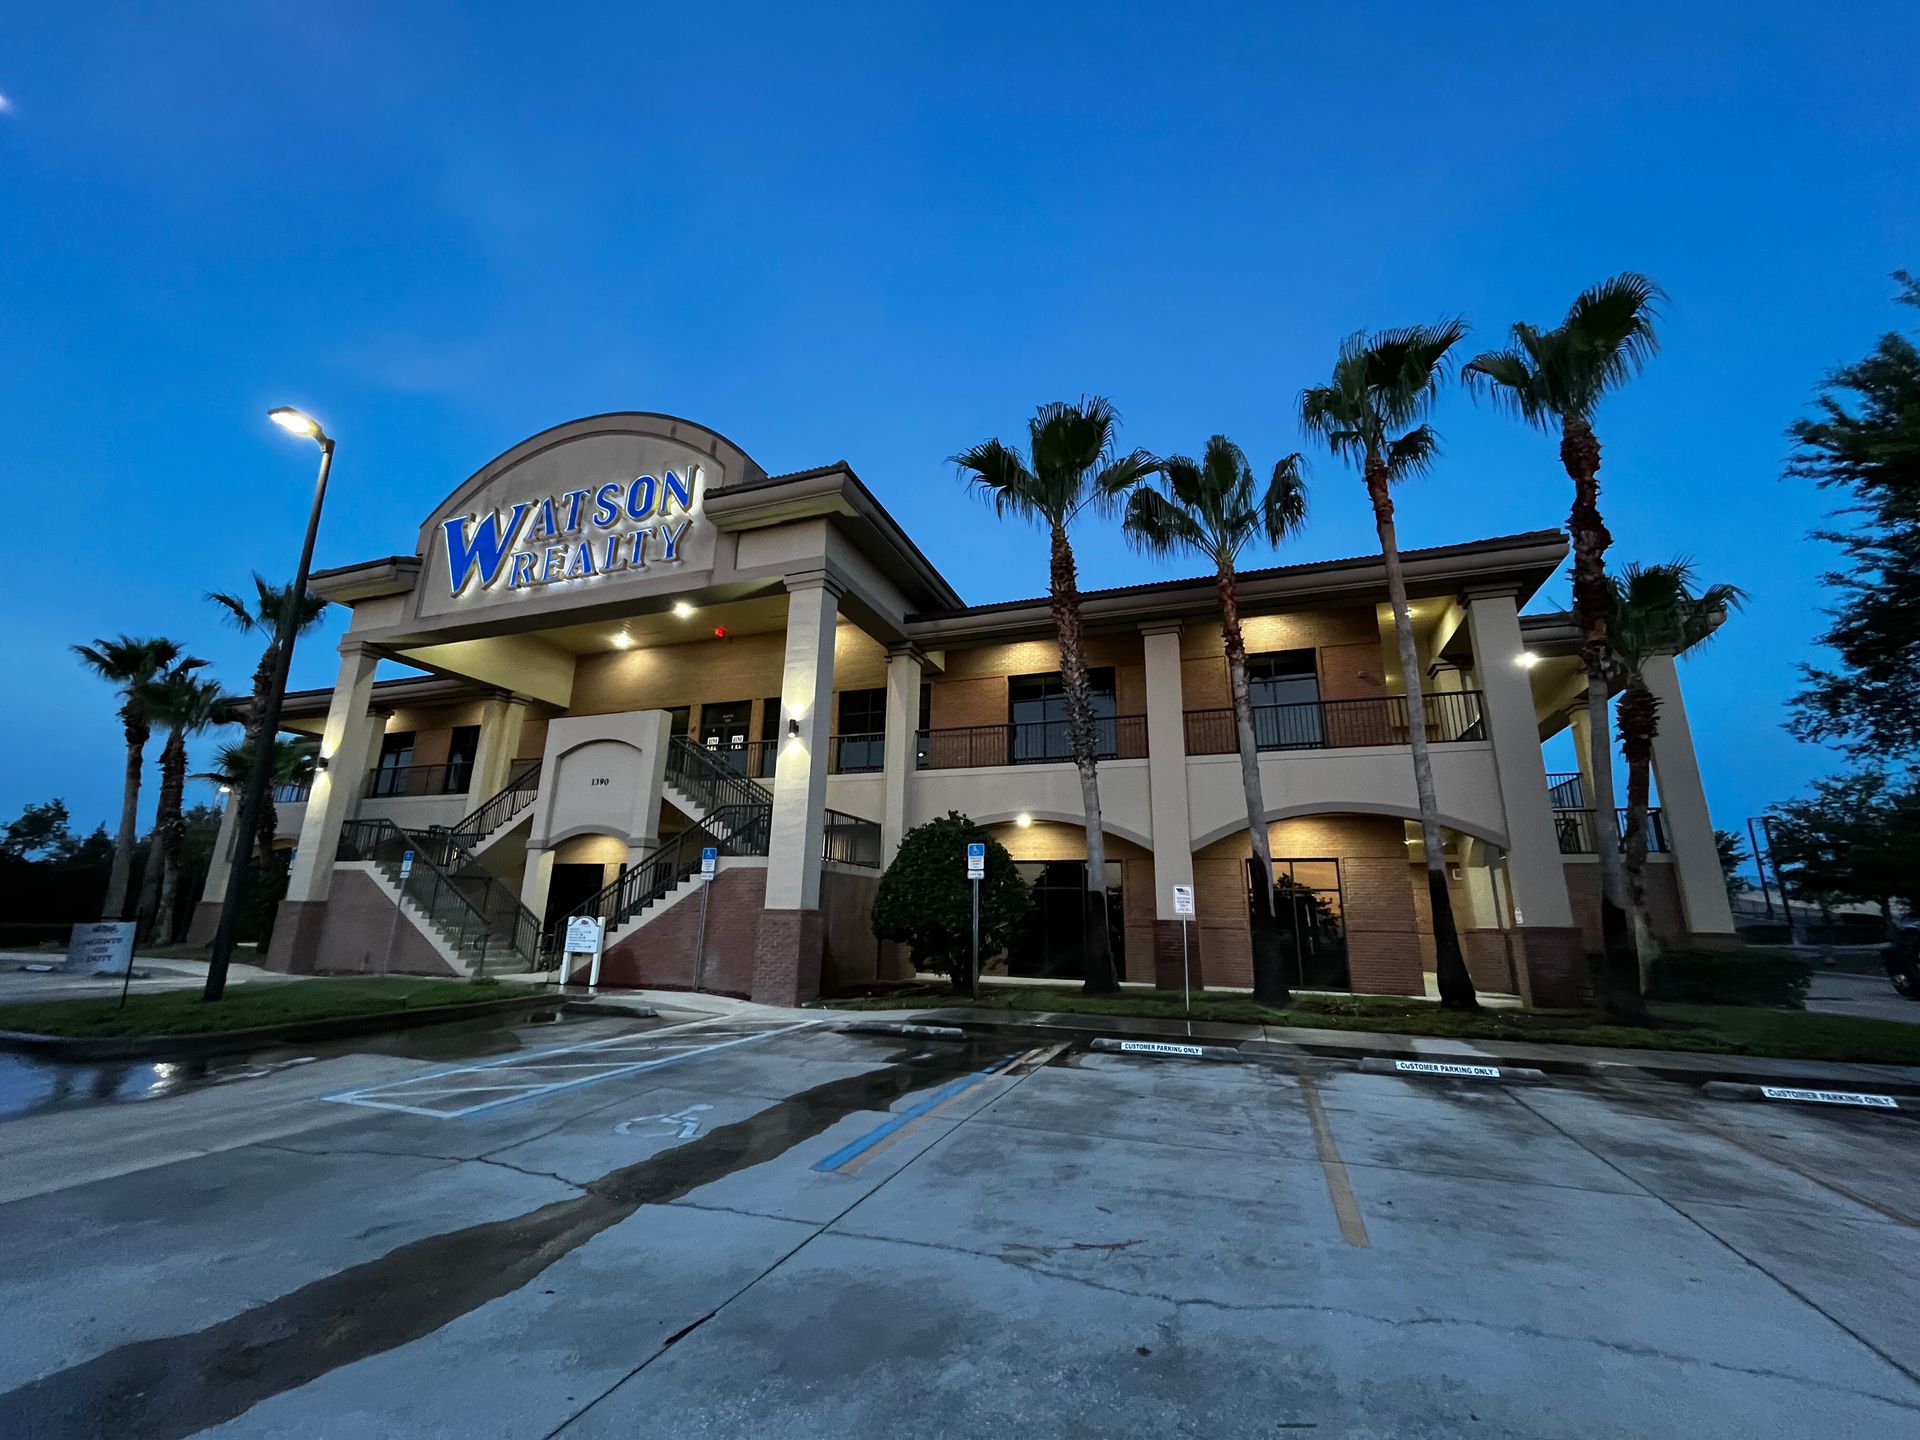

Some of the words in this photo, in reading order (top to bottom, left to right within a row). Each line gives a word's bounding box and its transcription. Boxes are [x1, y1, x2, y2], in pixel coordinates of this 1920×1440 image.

[442, 464, 698, 598] WATSON
[506, 519, 692, 590] REALTY
[591, 778, 610, 786] 1390
[1156, 1045, 1182, 1053] PARKING
[1400, 1062, 1439, 1072] CUSTOMER
[1440, 1065, 1472, 1074] PARKING
[1767, 1089, 1818, 1100] CUSTOMER
[1820, 1093, 1863, 1104] PARKING
[1864, 1096, 1890, 1105] ONLY
